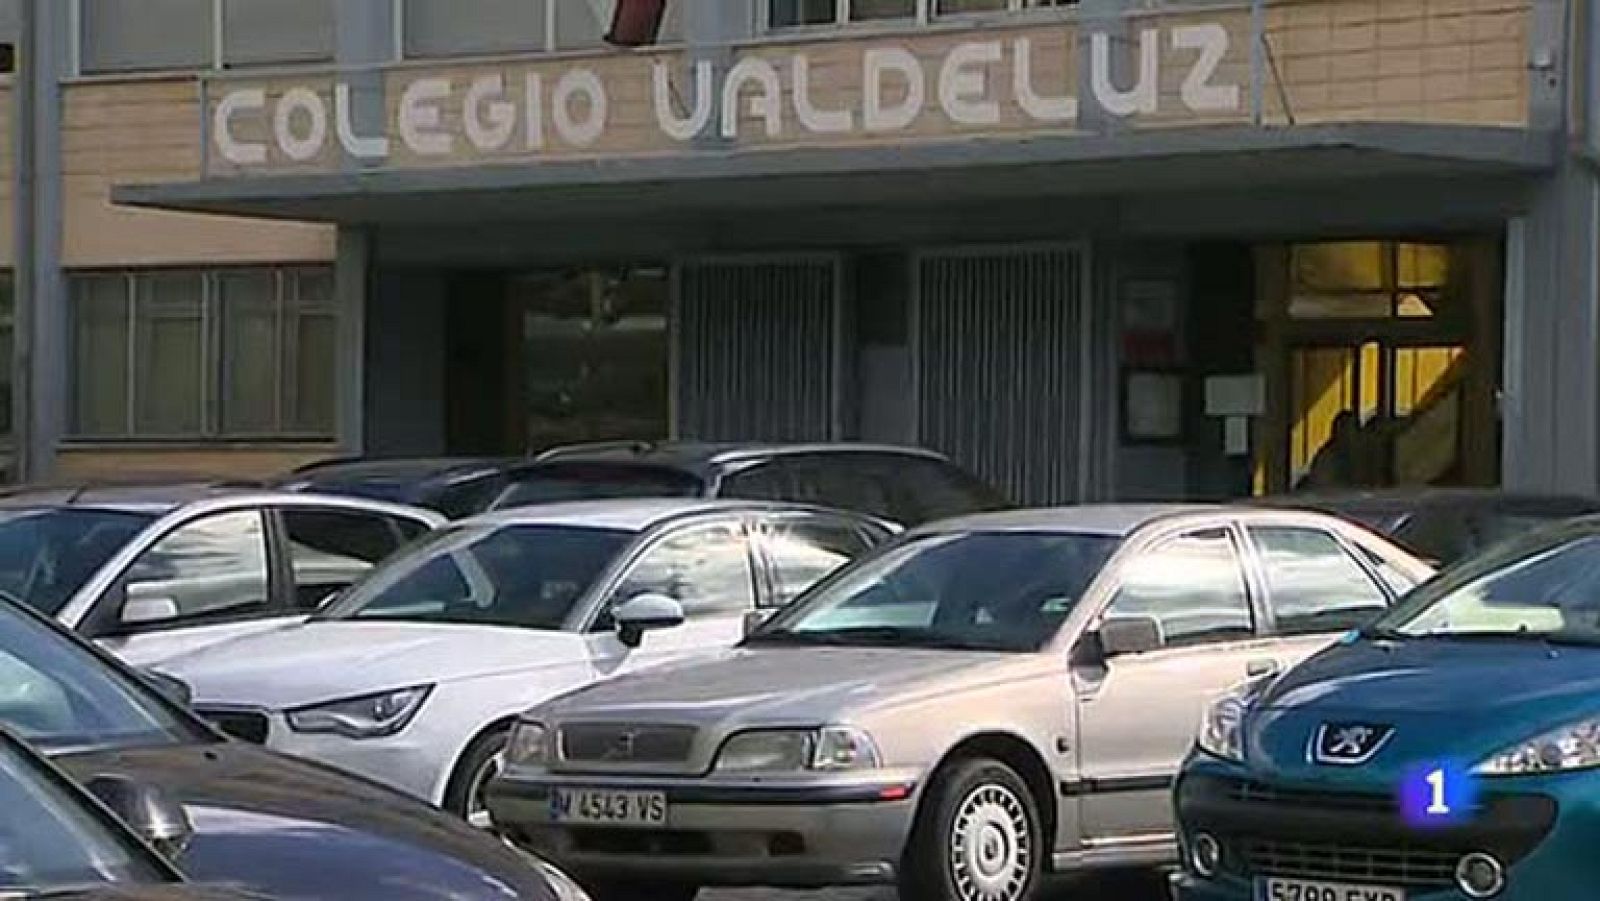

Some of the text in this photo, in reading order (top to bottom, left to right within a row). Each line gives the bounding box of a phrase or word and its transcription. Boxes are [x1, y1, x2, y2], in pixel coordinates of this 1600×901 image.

[213, 24, 1241, 164] COLEGIO VALDELUZ
[579, 793, 629, 818] 4543
[636, 795, 664, 821] VS
